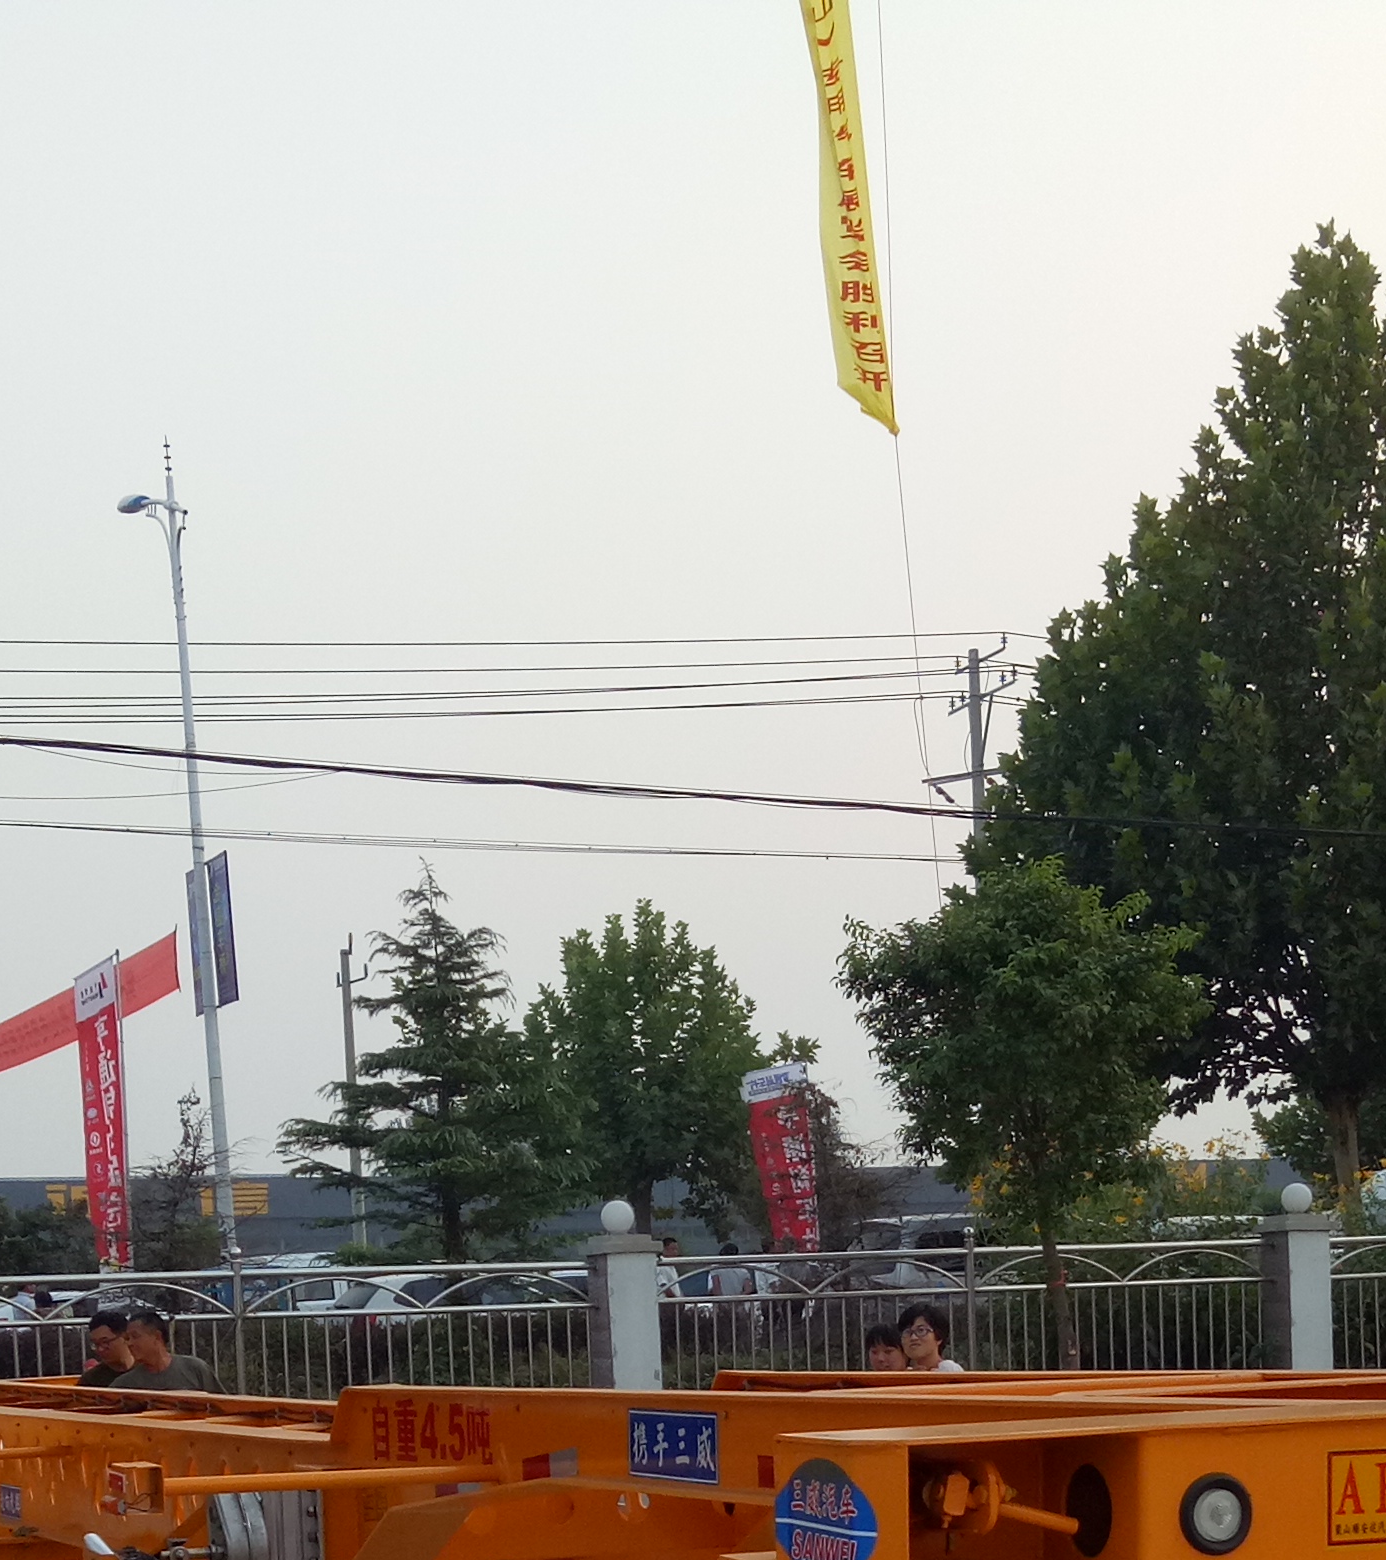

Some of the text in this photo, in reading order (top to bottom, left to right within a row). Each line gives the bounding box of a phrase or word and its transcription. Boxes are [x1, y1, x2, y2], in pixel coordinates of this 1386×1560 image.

[372, 1398, 493, 1465] 自重4.5吨
[633, 1421, 715, 1472] 携手三威
[791, 1479, 858, 1525] 三威汽车
